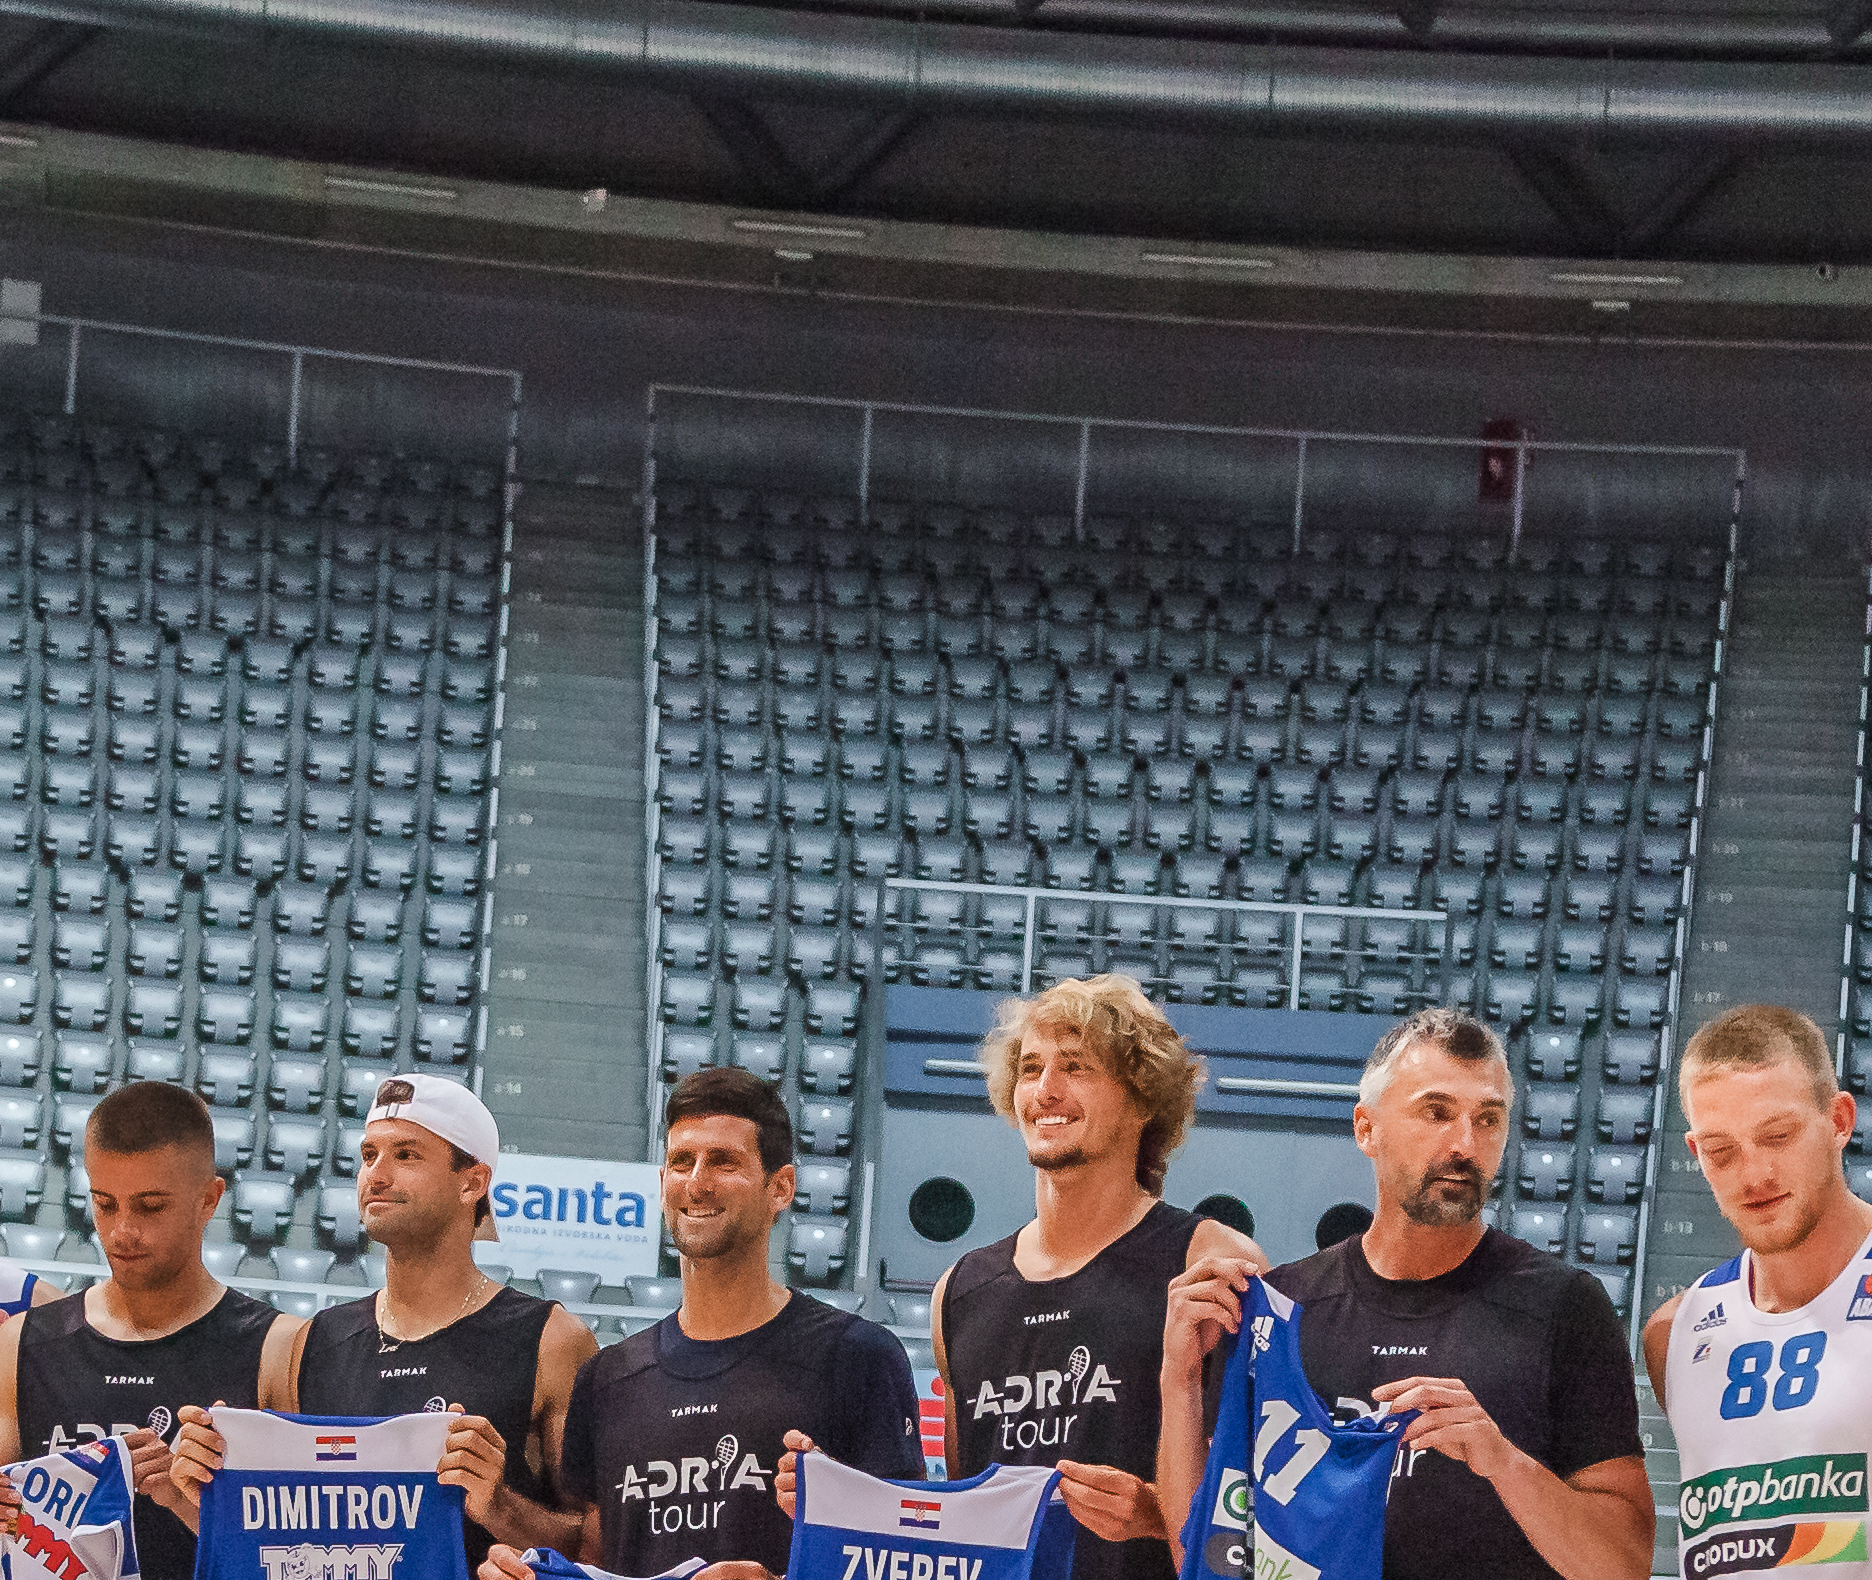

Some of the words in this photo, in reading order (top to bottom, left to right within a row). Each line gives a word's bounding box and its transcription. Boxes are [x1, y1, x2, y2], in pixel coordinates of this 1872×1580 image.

[1023, 1308, 1071, 1326] TARMAK
[1371, 1344, 1429, 1357] TARMAK
[104, 1374, 156, 1386] TARMAK
[380, 1366, 428, 1379] TARMAK
[966, 1345, 1121, 1421] ADRIA
[1719, 1330, 1828, 1421] 88
[670, 1402, 719, 1418] TARMAK
[1001, 1411, 1079, 1452] tour
[615, 1434, 773, 1504] ADRIA
[1707, 1460, 1866, 1518] otpbanka
[21, 1466, 89, 1530] ORI
[241, 1483, 425, 1532] DIMITROV
[648, 1495, 726, 1535] tour
